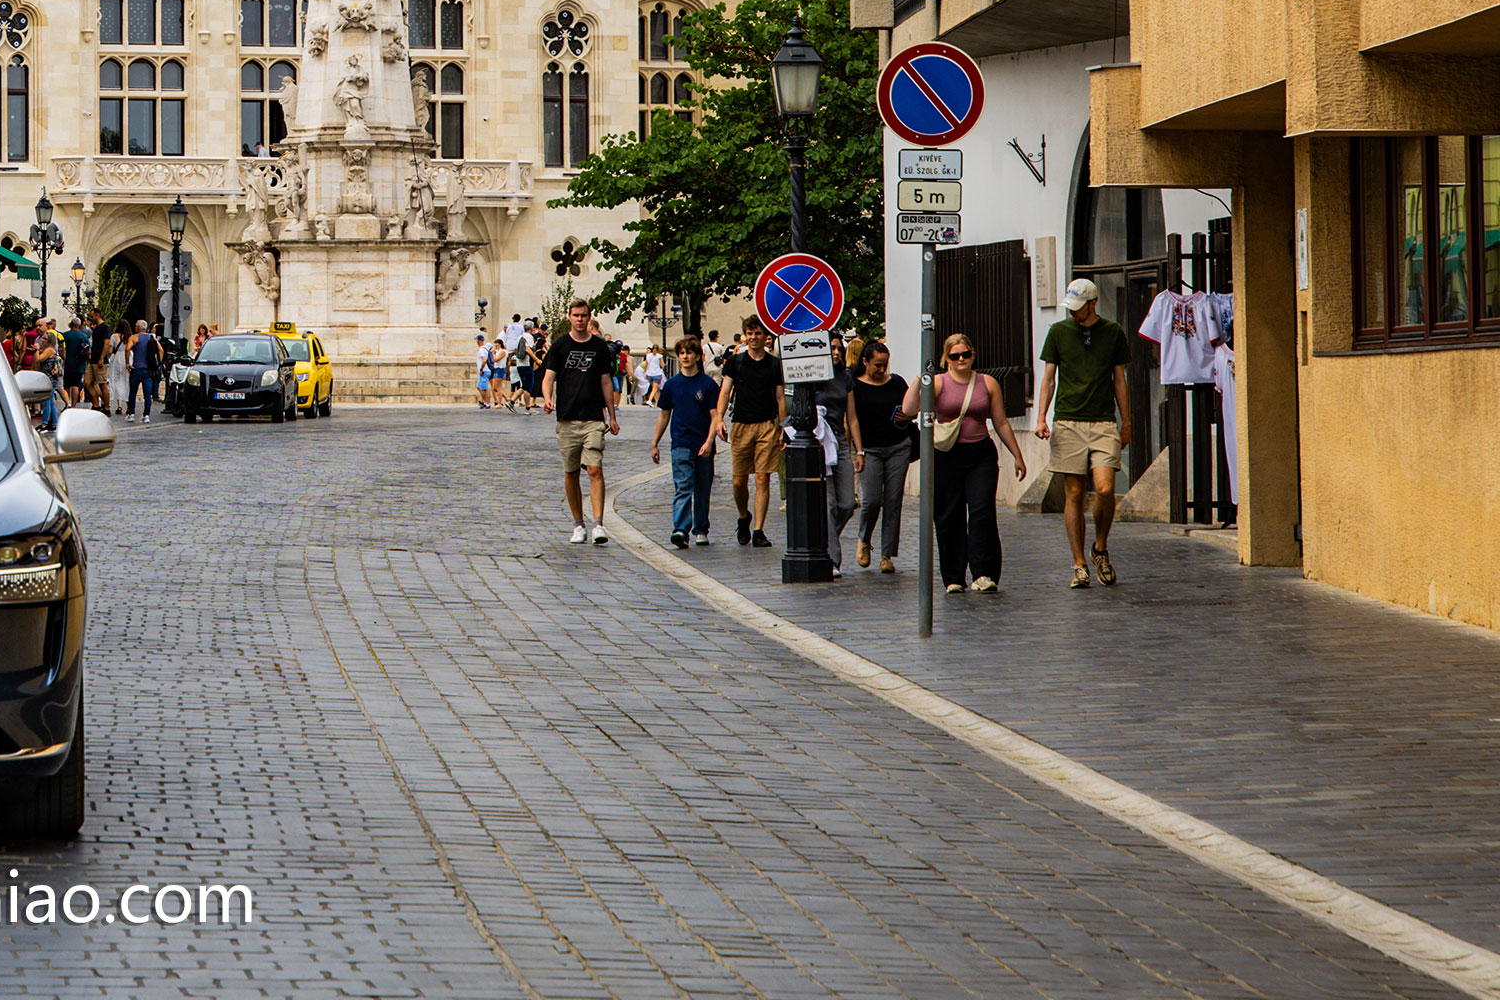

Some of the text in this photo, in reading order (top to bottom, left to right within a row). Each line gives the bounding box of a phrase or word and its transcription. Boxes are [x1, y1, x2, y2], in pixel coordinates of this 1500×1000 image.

[918, 154, 942, 162] KIVÉVE
[914, 188, 945, 204] 5 m
